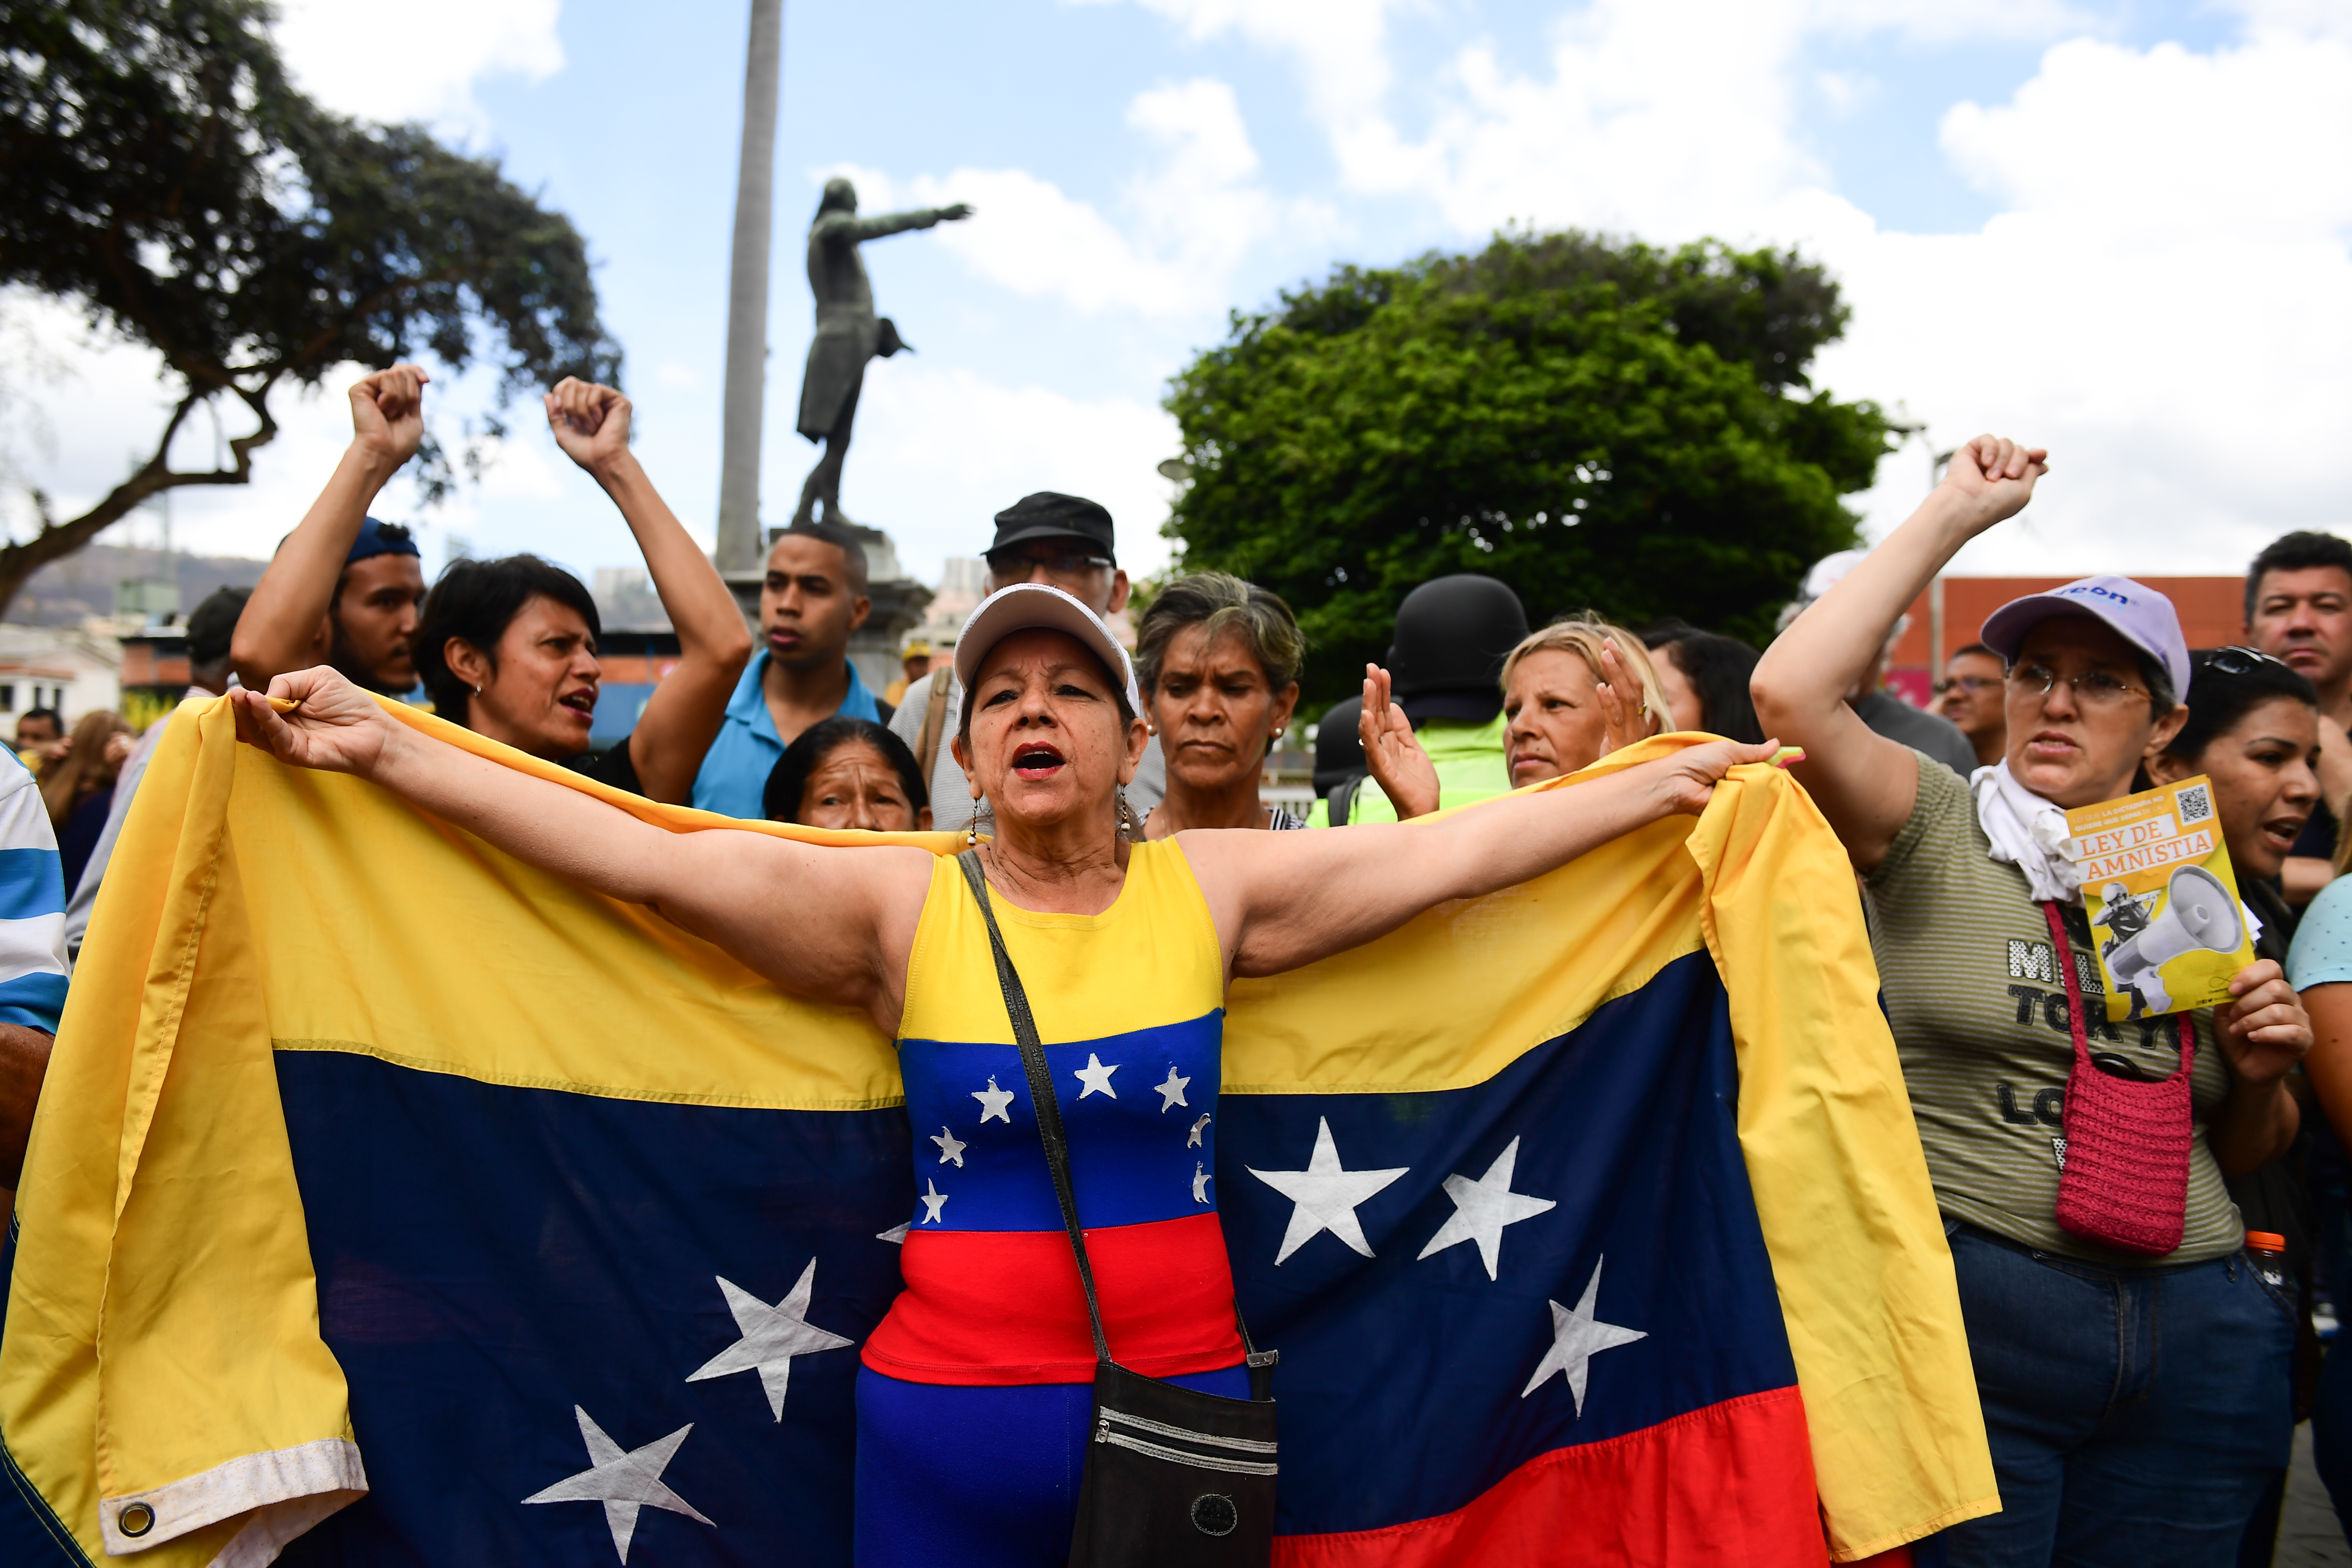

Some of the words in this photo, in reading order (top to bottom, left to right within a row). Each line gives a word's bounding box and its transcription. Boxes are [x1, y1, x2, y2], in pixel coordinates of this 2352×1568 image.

[2073, 816, 2084, 824] LO
[2085, 811, 2100, 822] QUE
[2113, 800, 2152, 814] DICTADURA
[2074, 821, 2103, 832] QUIERE
[2104, 817, 2120, 826] QUE
[2121, 811, 2142, 821] SEPAS
[2080, 830, 2125, 857] LEY
[2130, 821, 2163, 844] DE
[2087, 834, 2211, 880] AMNISTIA
